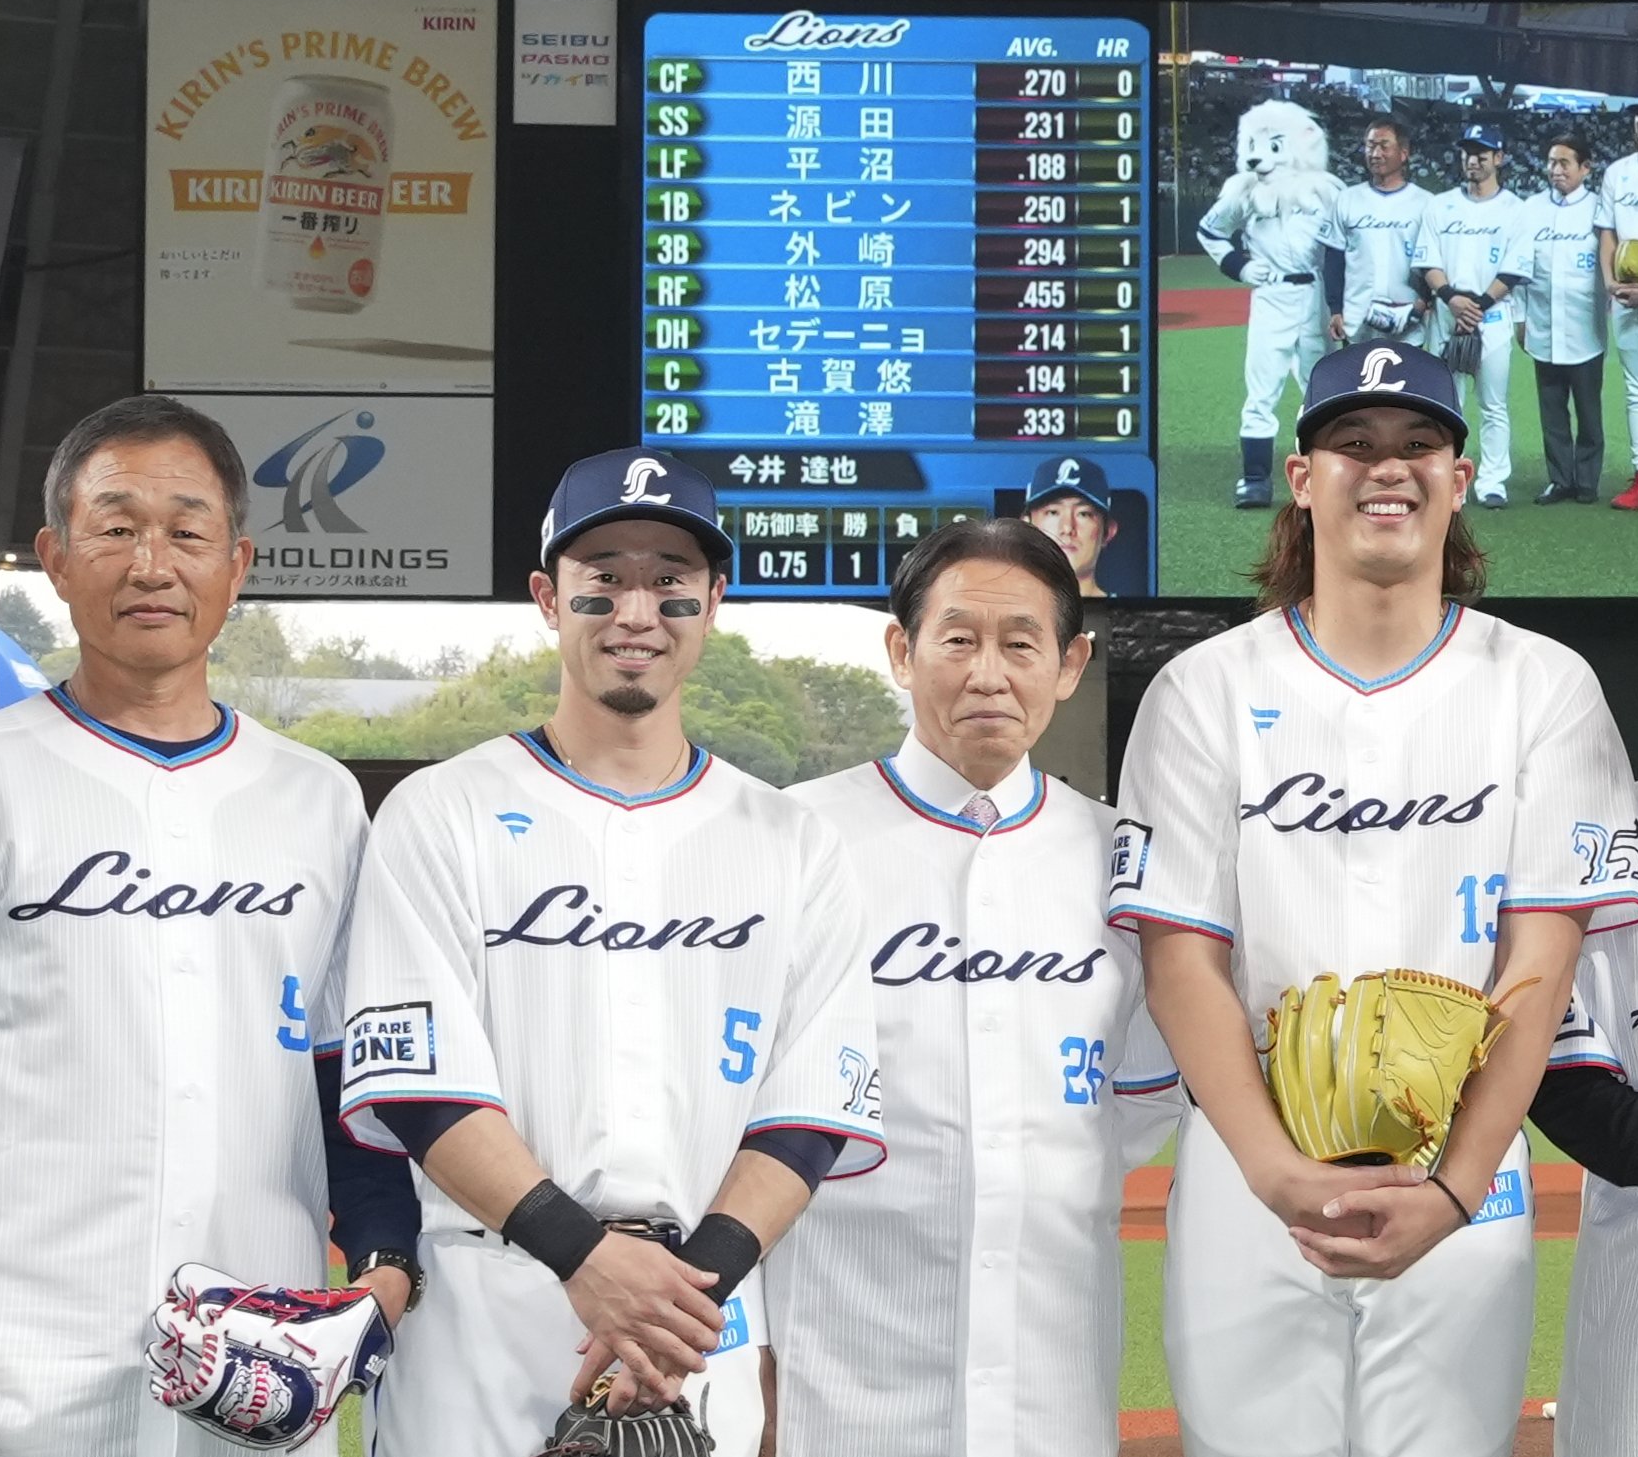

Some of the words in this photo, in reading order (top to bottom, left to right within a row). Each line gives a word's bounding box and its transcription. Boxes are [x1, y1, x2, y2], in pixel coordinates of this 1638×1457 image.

[422, 17, 476, 31] KIRIN
[521, 34, 610, 47] SEIBU
[745, 10, 909, 51] Lions
[521, 54, 610, 66] PASMO
[1007, 37, 1058, 59] AVG.
[1097, 39, 1129, 56] HR
[155, 39, 271, 141] KIRIN'S
[282, 31, 400, 71] PRIME
[402, 55, 488, 141] BREW
[660, 64, 686, 92] CF
[787, 61, 892, 95] 西川
[1019, 69, 1066, 96] .270
[659, 106, 688, 135] SS
[787, 106, 893, 140] 源田
[1018, 112, 1063, 139] .231
[661, 149, 685, 178] LF
[787, 147, 893, 182] 平沼
[1018, 153, 1065, 180] .188
[271, 180, 327, 205] KIRIN
[331, 187, 380, 211] BEER
[661, 192, 689, 221] 1B
[770, 190, 911, 224] ネビン
[1018, 196, 1065, 223] .250
[282, 211, 359, 235] 一番搾り
[658, 235, 688, 264] 3B
[786, 231, 894, 267] 外崎
[1018, 238, 1065, 266] .294
[659, 276, 687, 306] RF
[785, 274, 892, 308] 松原
[1018, 281, 1065, 308] .455
[657, 319, 688, 349] DH
[749, 318, 924, 353] セデーニョ
[1018, 324, 1065, 351] .214
[665, 362, 679, 390] C
[767, 358, 911, 394] 古賀悠
[1018, 365, 1065, 392] .194
[657, 404, 687, 433] 2B
[785, 400, 893, 436] 滝澤
[1018, 408, 1065, 435] .333
[728, 455, 786, 485] 今井
[800, 455, 858, 485] 達也
[746, 512, 819, 537] 防御率
[842, 511, 867, 537] 勝
[253, 547, 449, 570] HOLDINGS
[759, 551, 807, 578] 0.75
[851, 552, 860, 578] 1
[1240, 772, 1499, 835] Lions
[8, 850, 305, 921] Lions
[484, 885, 765, 952] Lions
[871, 922, 1108, 985] Lions
[353, 1021, 372, 1040] WE
[377, 1020, 412, 1035] ARE
[719, 1007, 761, 1085] 5
[351, 1037, 415, 1067] ONE
[1059, 1035, 1105, 1105] 26
